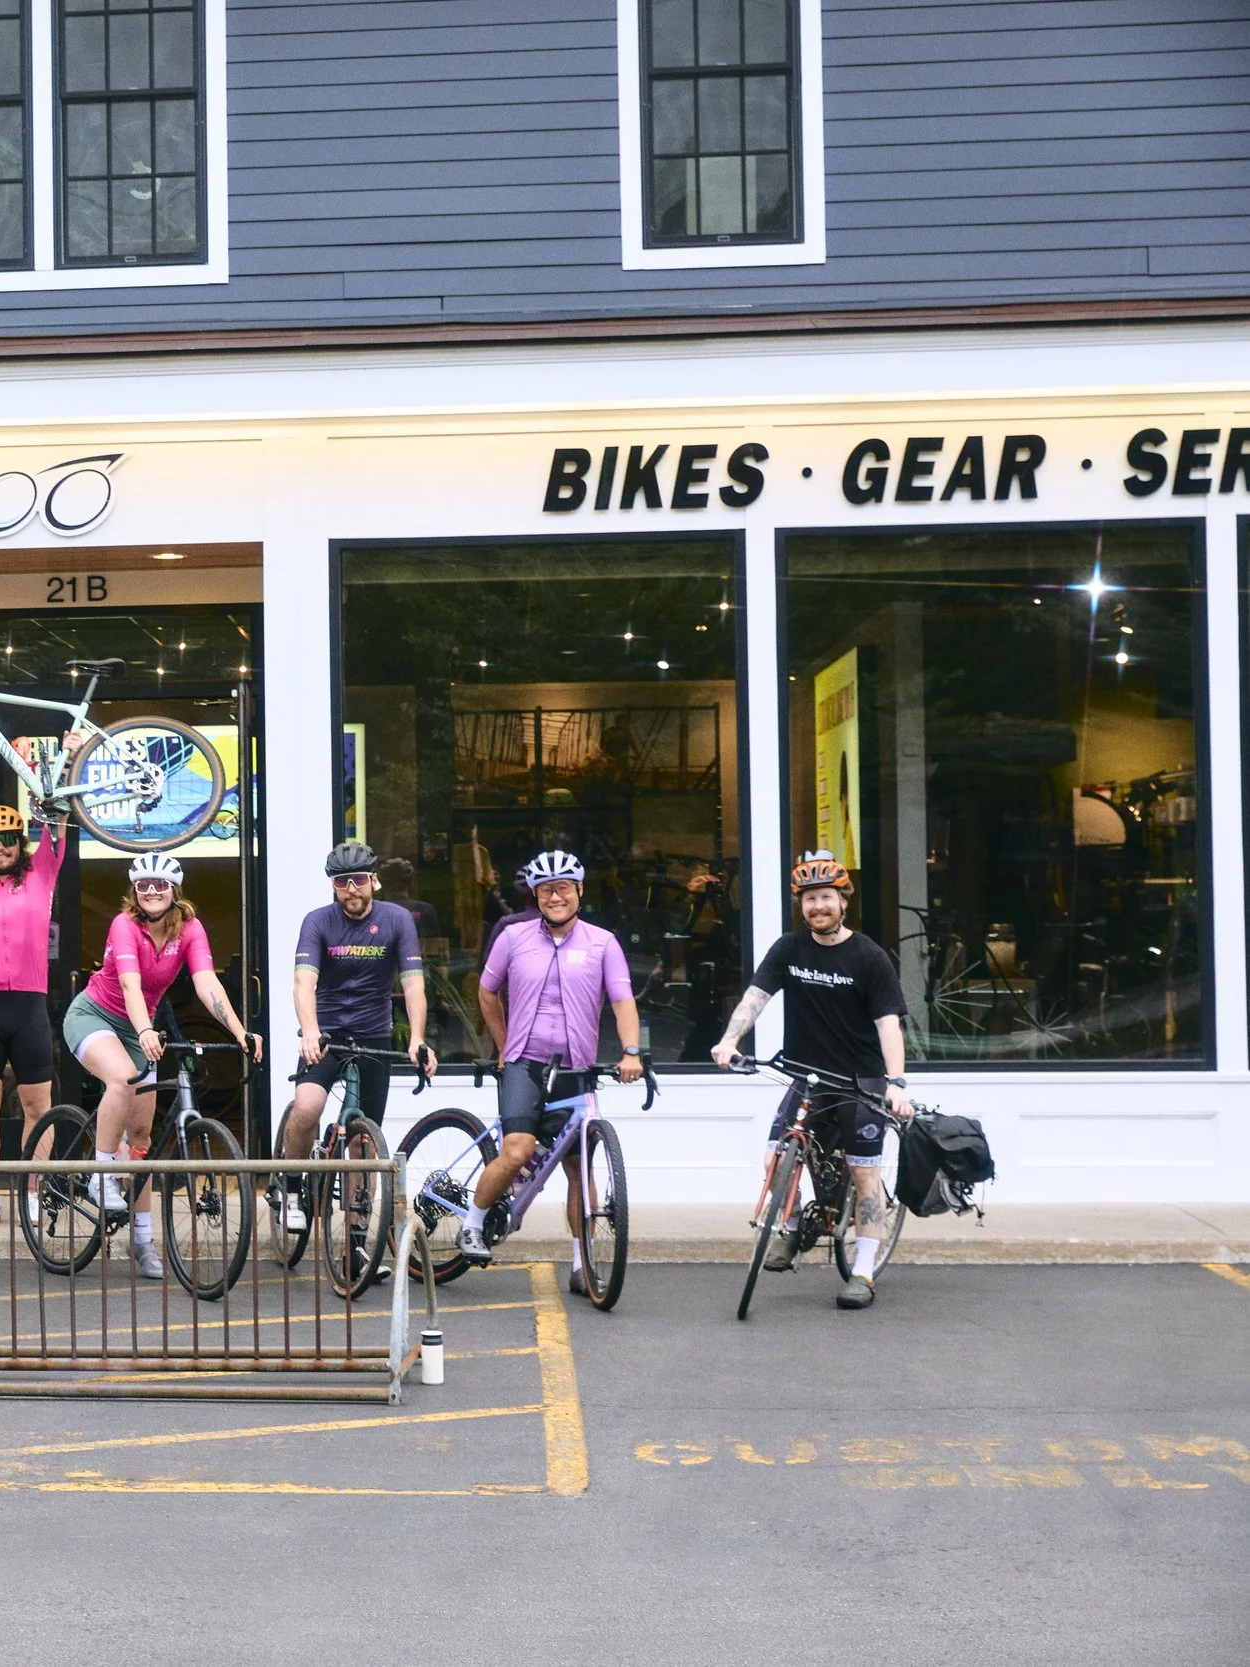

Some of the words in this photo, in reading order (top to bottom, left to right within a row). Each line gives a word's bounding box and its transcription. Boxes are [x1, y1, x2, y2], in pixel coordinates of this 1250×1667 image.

[542, 442, 769, 512] BIKES
[841, 434, 1047, 505] GEAR
[833, 972, 854, 985] love
